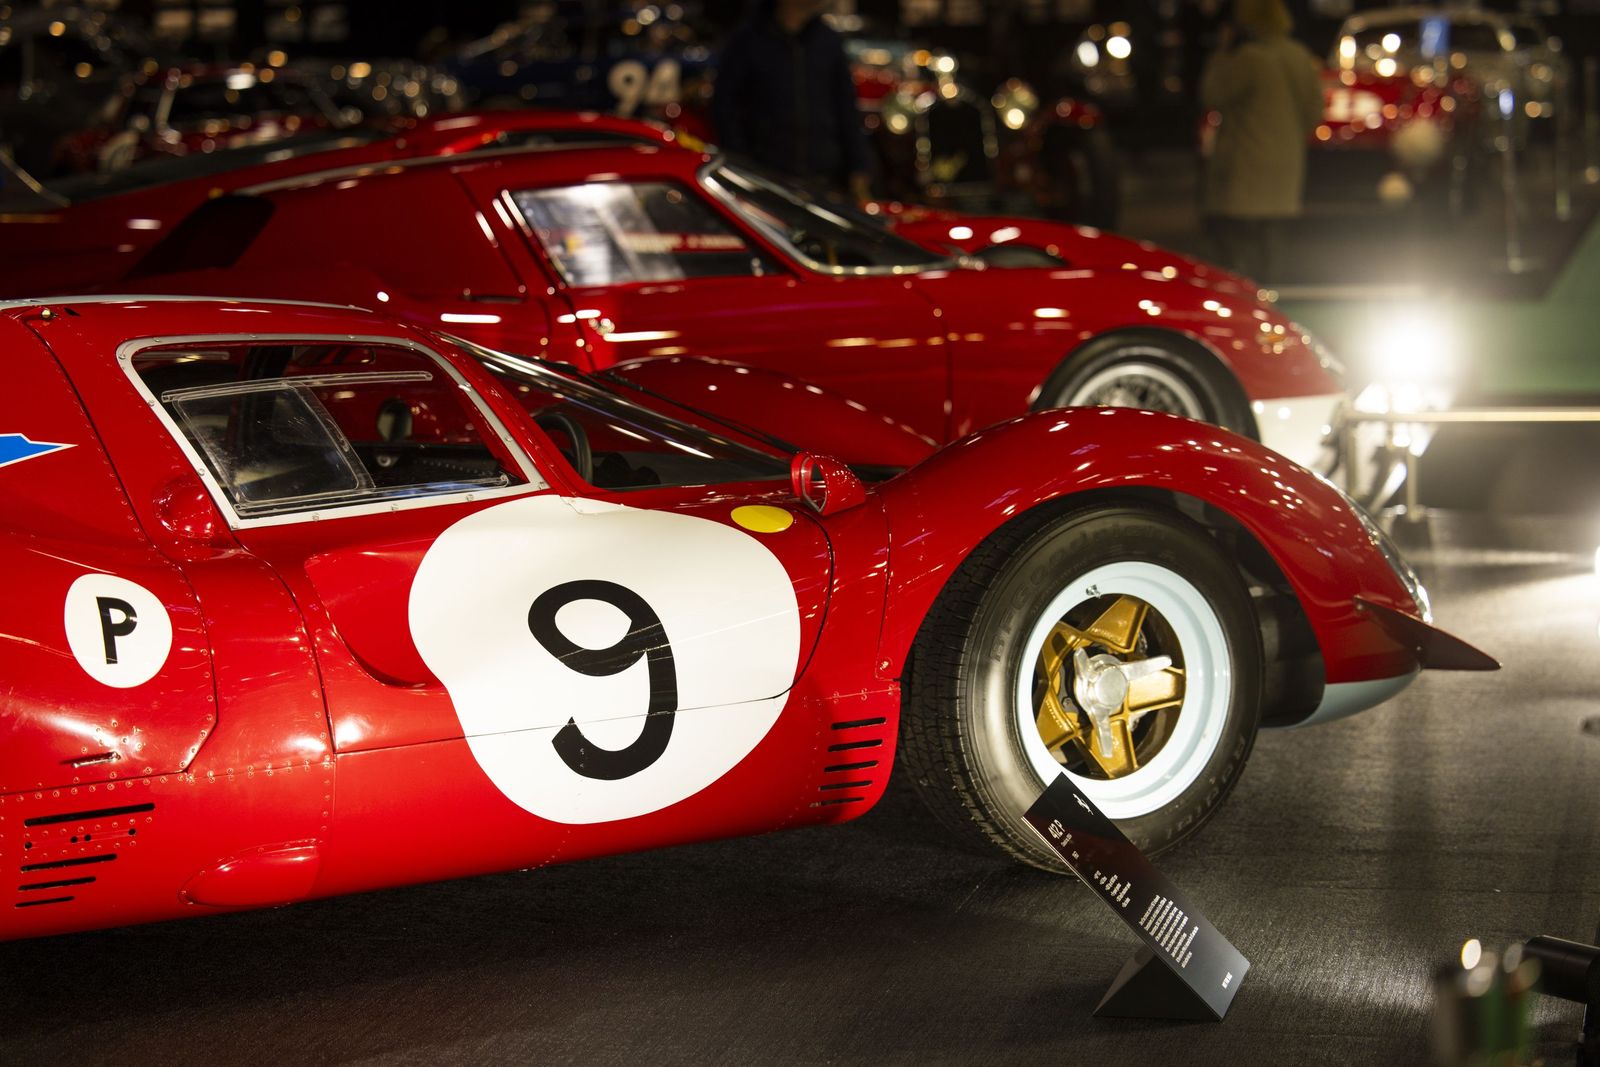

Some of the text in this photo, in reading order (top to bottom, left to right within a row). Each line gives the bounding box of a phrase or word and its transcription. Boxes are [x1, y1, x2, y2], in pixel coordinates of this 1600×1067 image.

[607, 58, 682, 117] 94
[96, 596, 138, 665] P
[528, 579, 678, 781] 9
